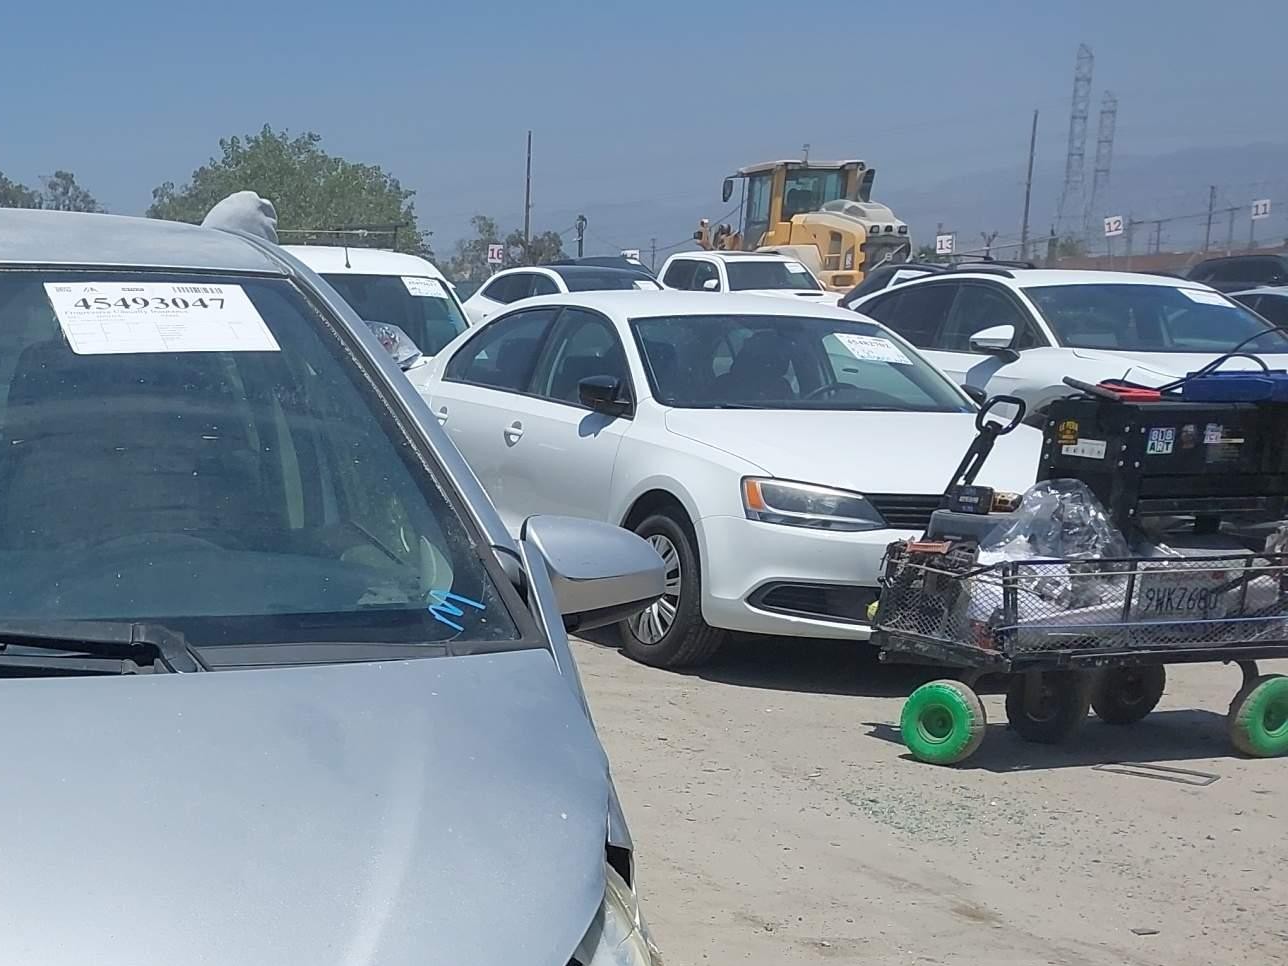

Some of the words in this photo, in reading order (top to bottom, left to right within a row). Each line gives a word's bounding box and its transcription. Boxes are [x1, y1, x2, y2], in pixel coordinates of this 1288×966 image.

[1254, 203, 1268, 216] 11
[1106, 220, 1122, 232] 12
[937, 239, 952, 250] 13
[74, 297, 225, 310] 45493047
[1149, 441, 1173, 453] ART
